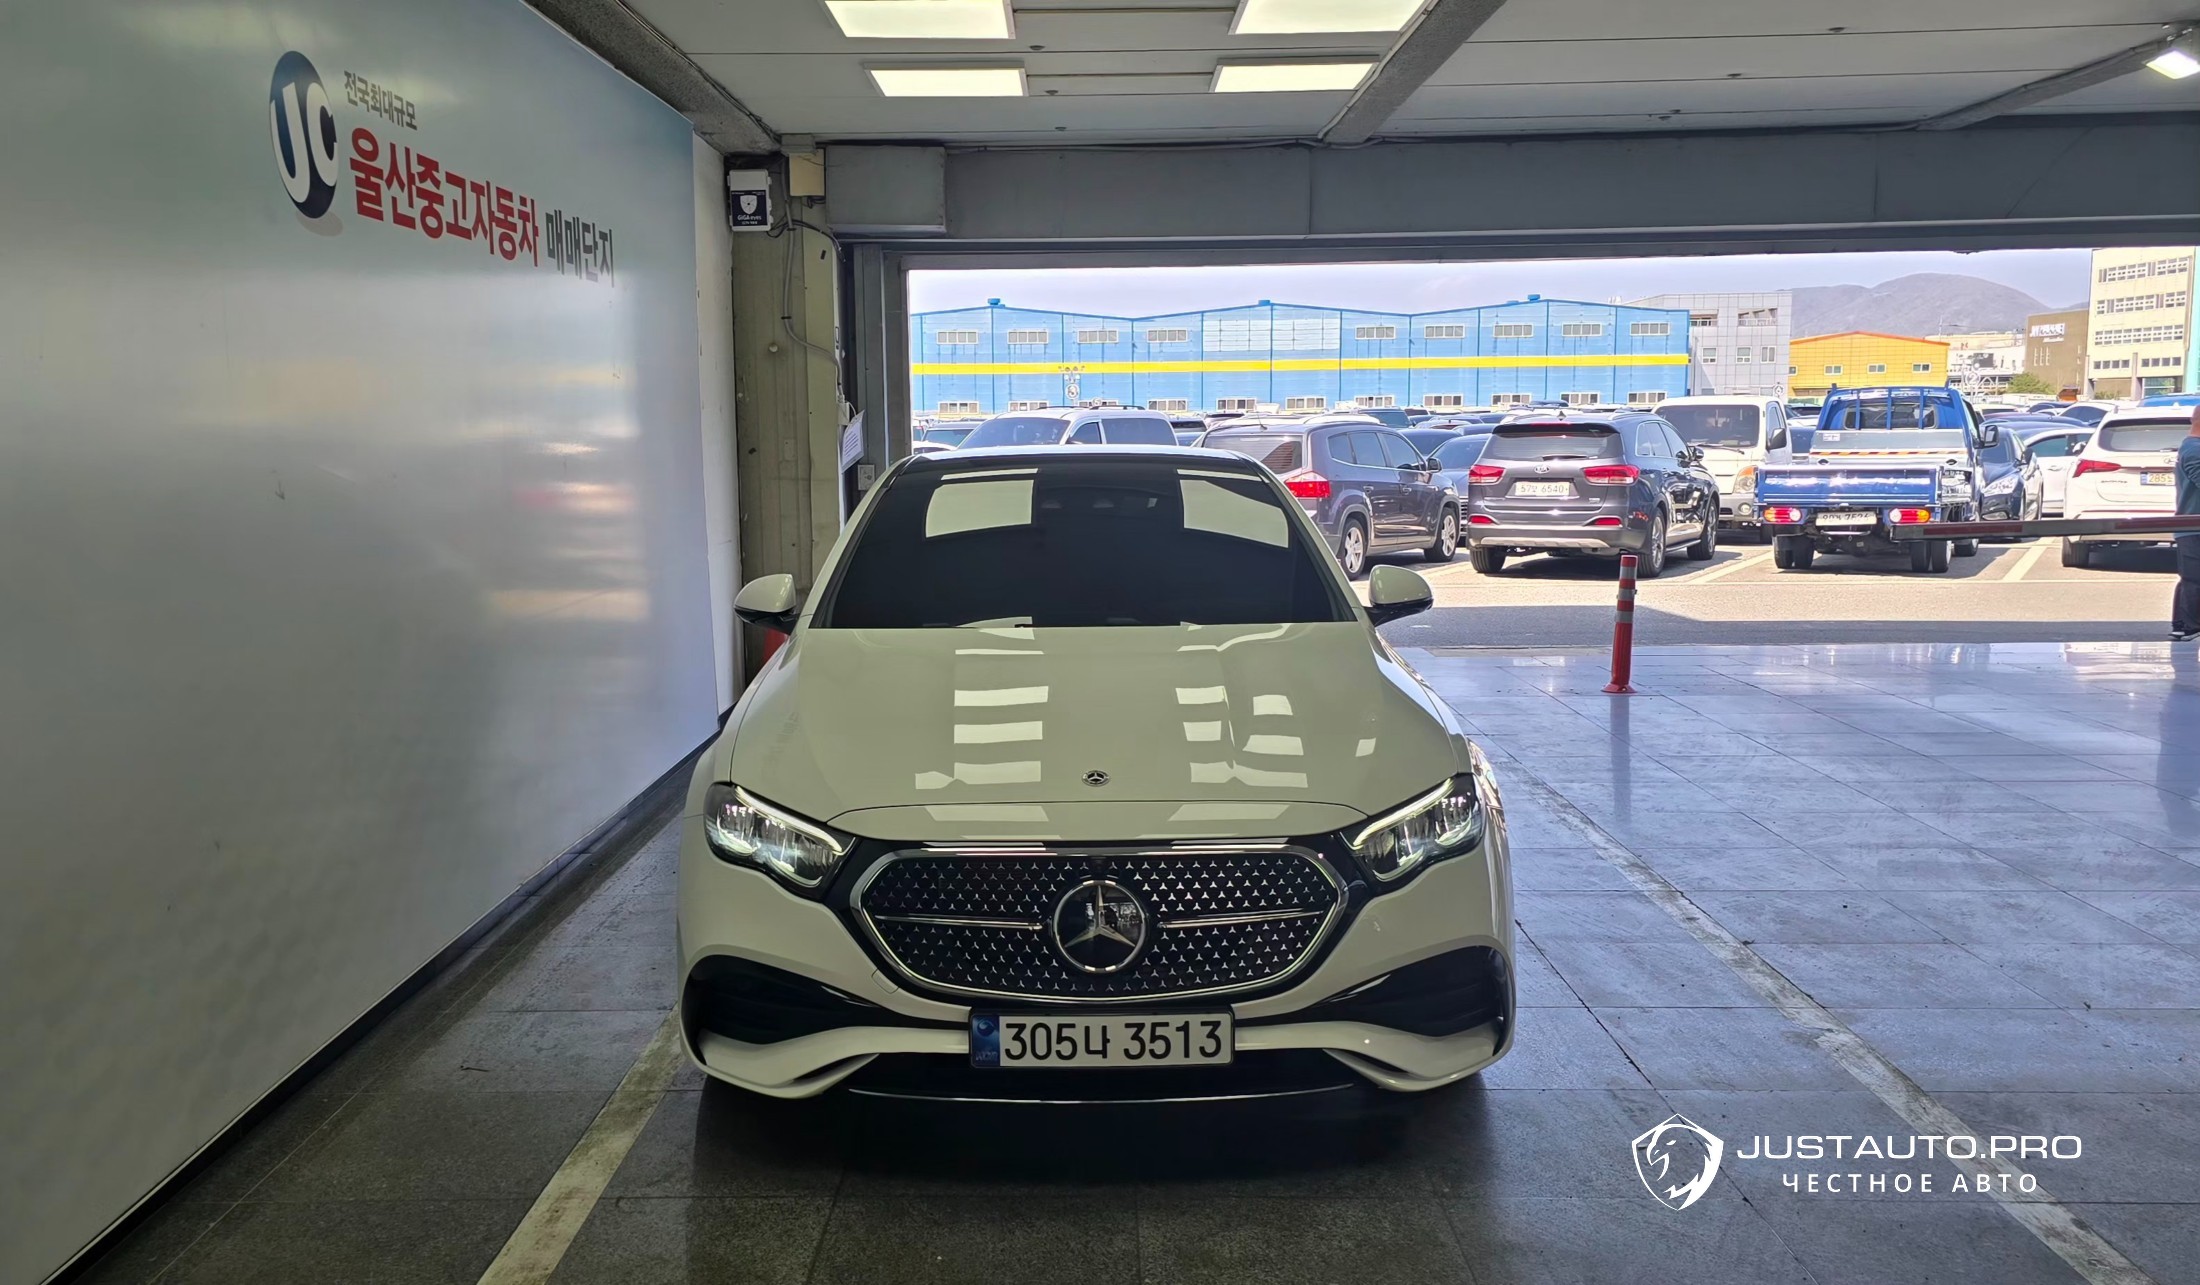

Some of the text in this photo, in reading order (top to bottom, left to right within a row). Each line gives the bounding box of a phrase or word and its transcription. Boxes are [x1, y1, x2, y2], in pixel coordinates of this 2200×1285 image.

[344, 70, 417, 131] 전국최대규모
[350, 127, 614, 288] 울산중고자동차 매매단지
[1541, 485, 1564, 493] 6540
[1005, 1020, 1222, 1061] 305나 3513
